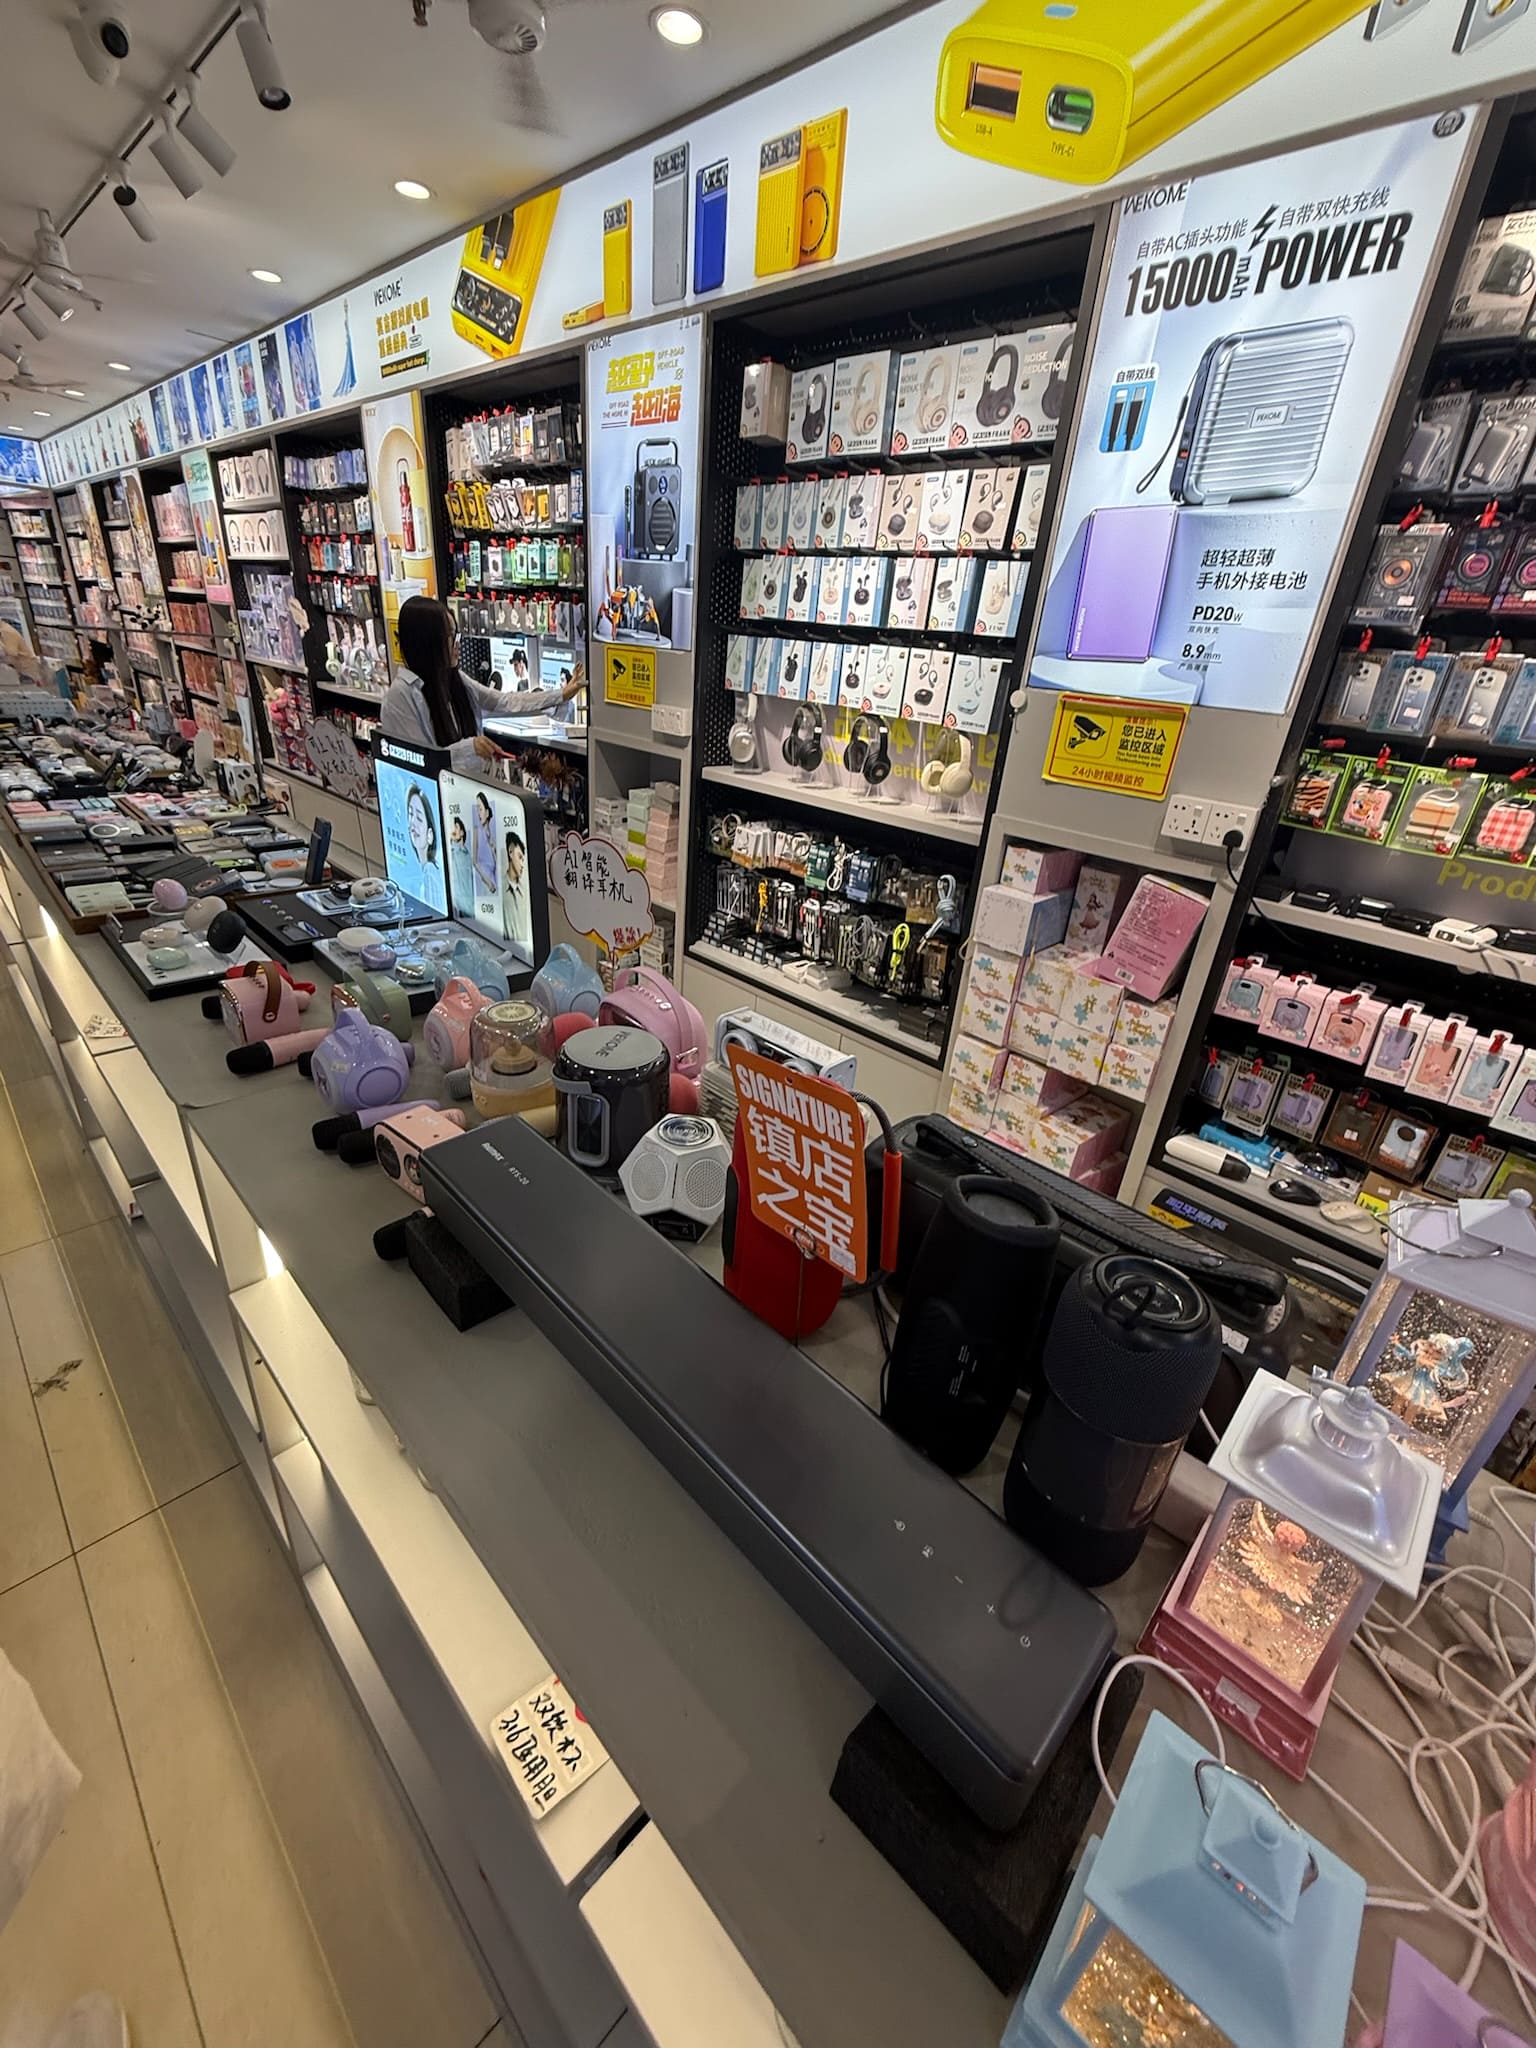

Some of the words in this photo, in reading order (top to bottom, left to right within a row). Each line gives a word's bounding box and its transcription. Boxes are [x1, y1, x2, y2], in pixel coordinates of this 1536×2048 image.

[1277, 184, 1391, 229] 自带双快充线
[1136, 217, 1249, 261] 自带AC插头功能
[1124, 246, 1239, 317] 15000
[1231, 256, 1253, 300] mAh
[1253, 210, 1414, 296] POWER
[1024, 351, 1049, 362] NOISE
[1115, 366, 1156, 383] 自带双线
[1200, 548, 1276, 569] 超轻超薄
[1196, 570, 1308, 591] 手机外接电池
[1192, 605, 1244, 624] PD20W
[1181, 643, 1221, 661] 8.9mm
[1122, 724, 1167, 742] 您已进入
[1118, 738, 1166, 756] 监控区域
[1072, 765, 1145, 787] 24小时视频监控
[503, 814, 518, 828] S200
[735, 1063, 856, 1149] SIGNATURE
[747, 1104, 853, 1205] 镇店
[757, 1167, 855, 1264] 之宝
